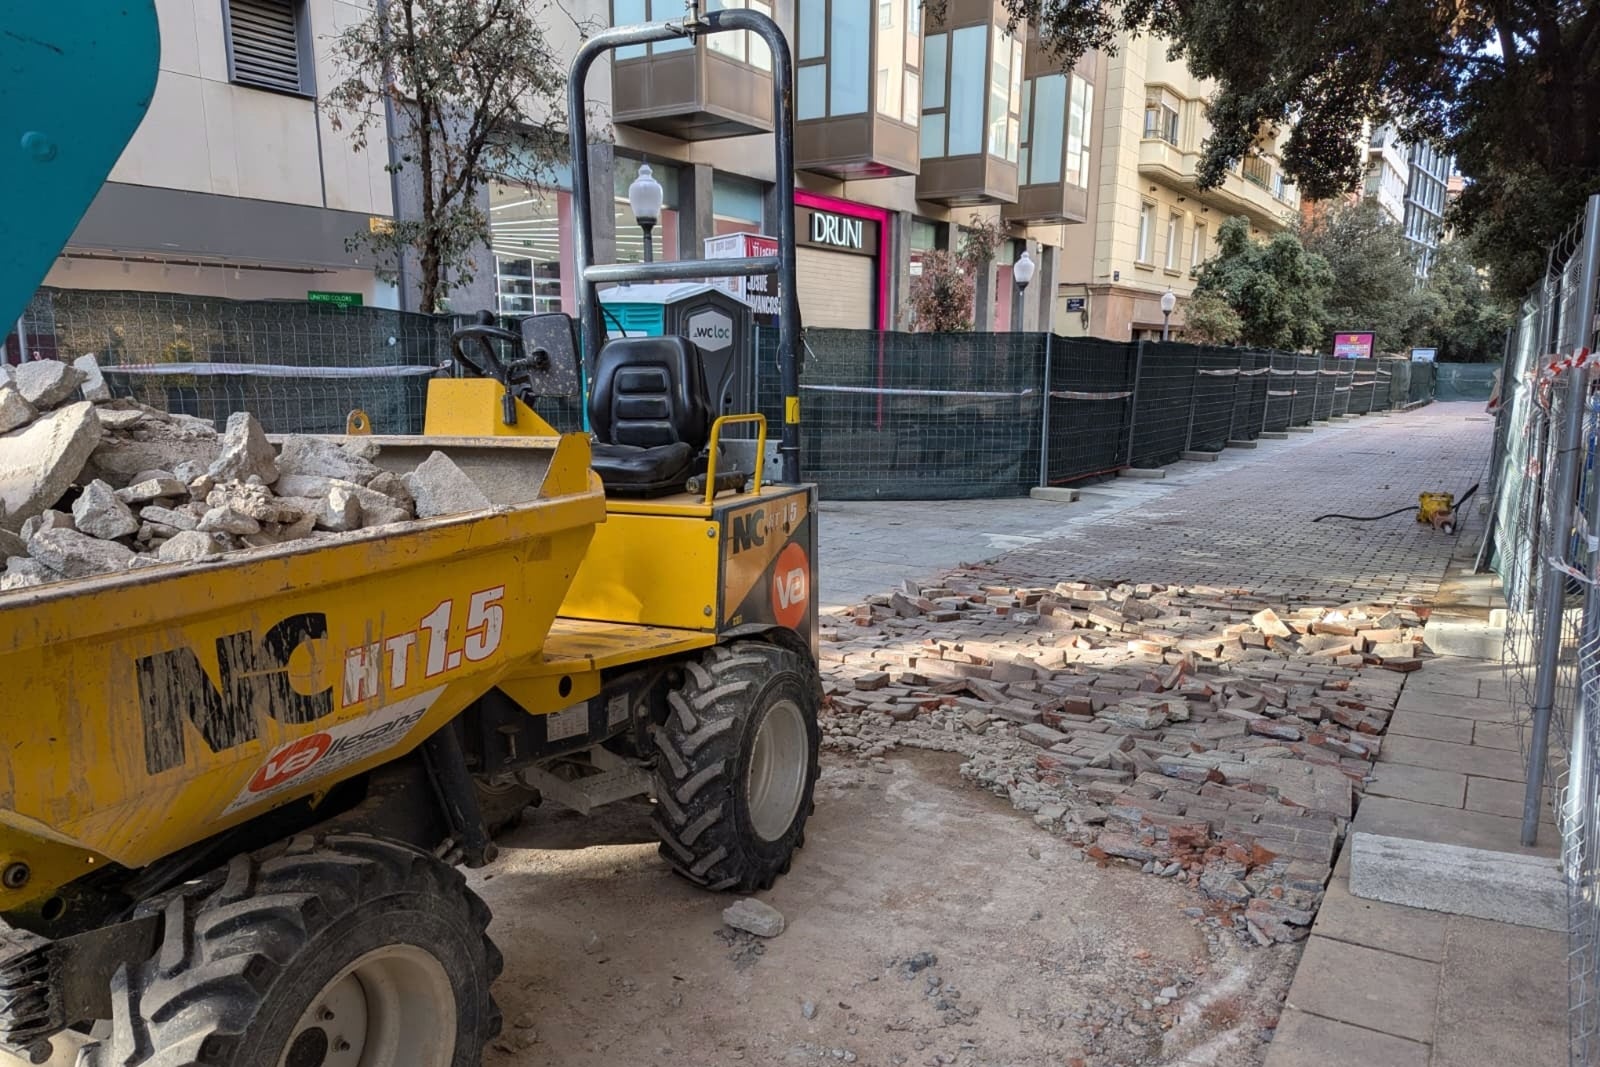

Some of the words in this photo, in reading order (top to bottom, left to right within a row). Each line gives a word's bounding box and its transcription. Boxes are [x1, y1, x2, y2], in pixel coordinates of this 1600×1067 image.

[814, 212, 863, 249] DRUNI
[733, 509, 764, 555] NC
[135, 612, 334, 776] NC
